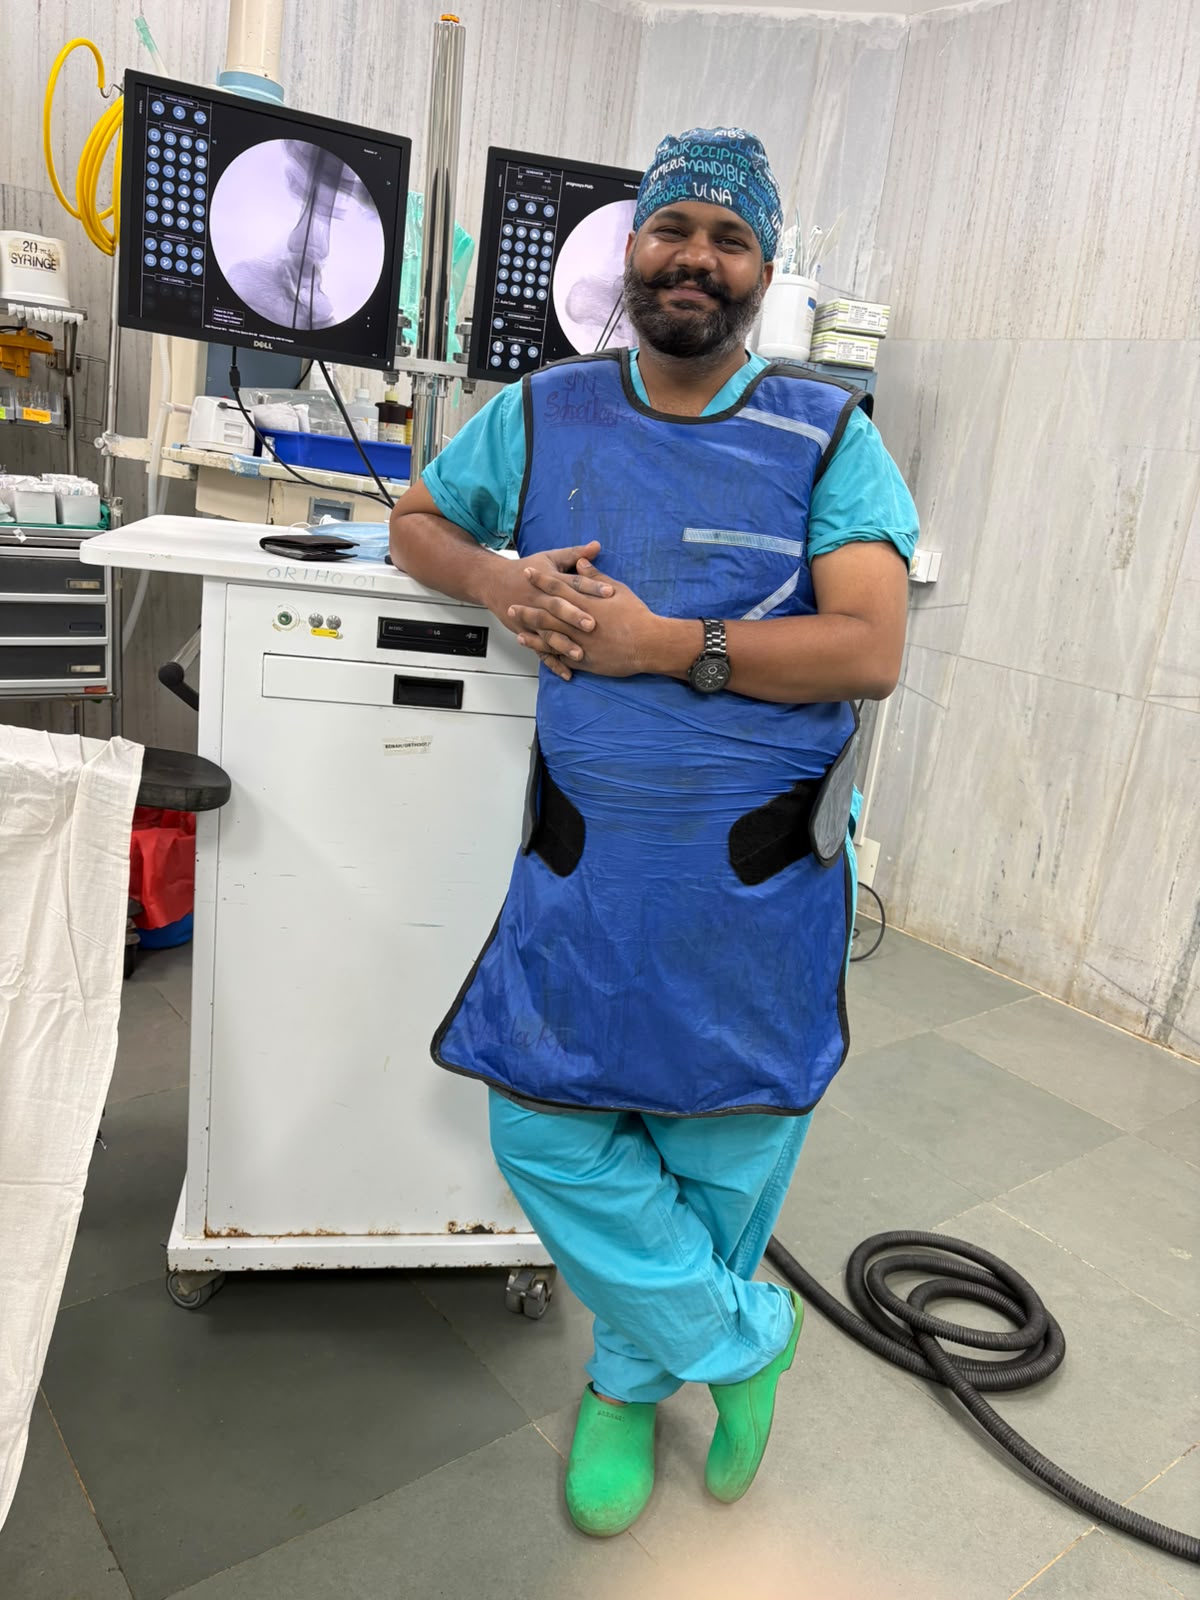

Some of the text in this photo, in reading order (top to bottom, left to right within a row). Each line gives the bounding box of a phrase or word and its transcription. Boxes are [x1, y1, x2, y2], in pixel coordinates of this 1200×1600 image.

[689, 144, 753, 177] OCCIPITAL
[683, 159, 747, 188] MANDIBLE
[712, 177, 739, 193] HYOID
[645, 183, 690, 213] TEMPORAL
[692, 182, 733, 206] ULNA
[10, 252, 57, 271] SYRINGE
[253, 340, 273, 350] DELL
